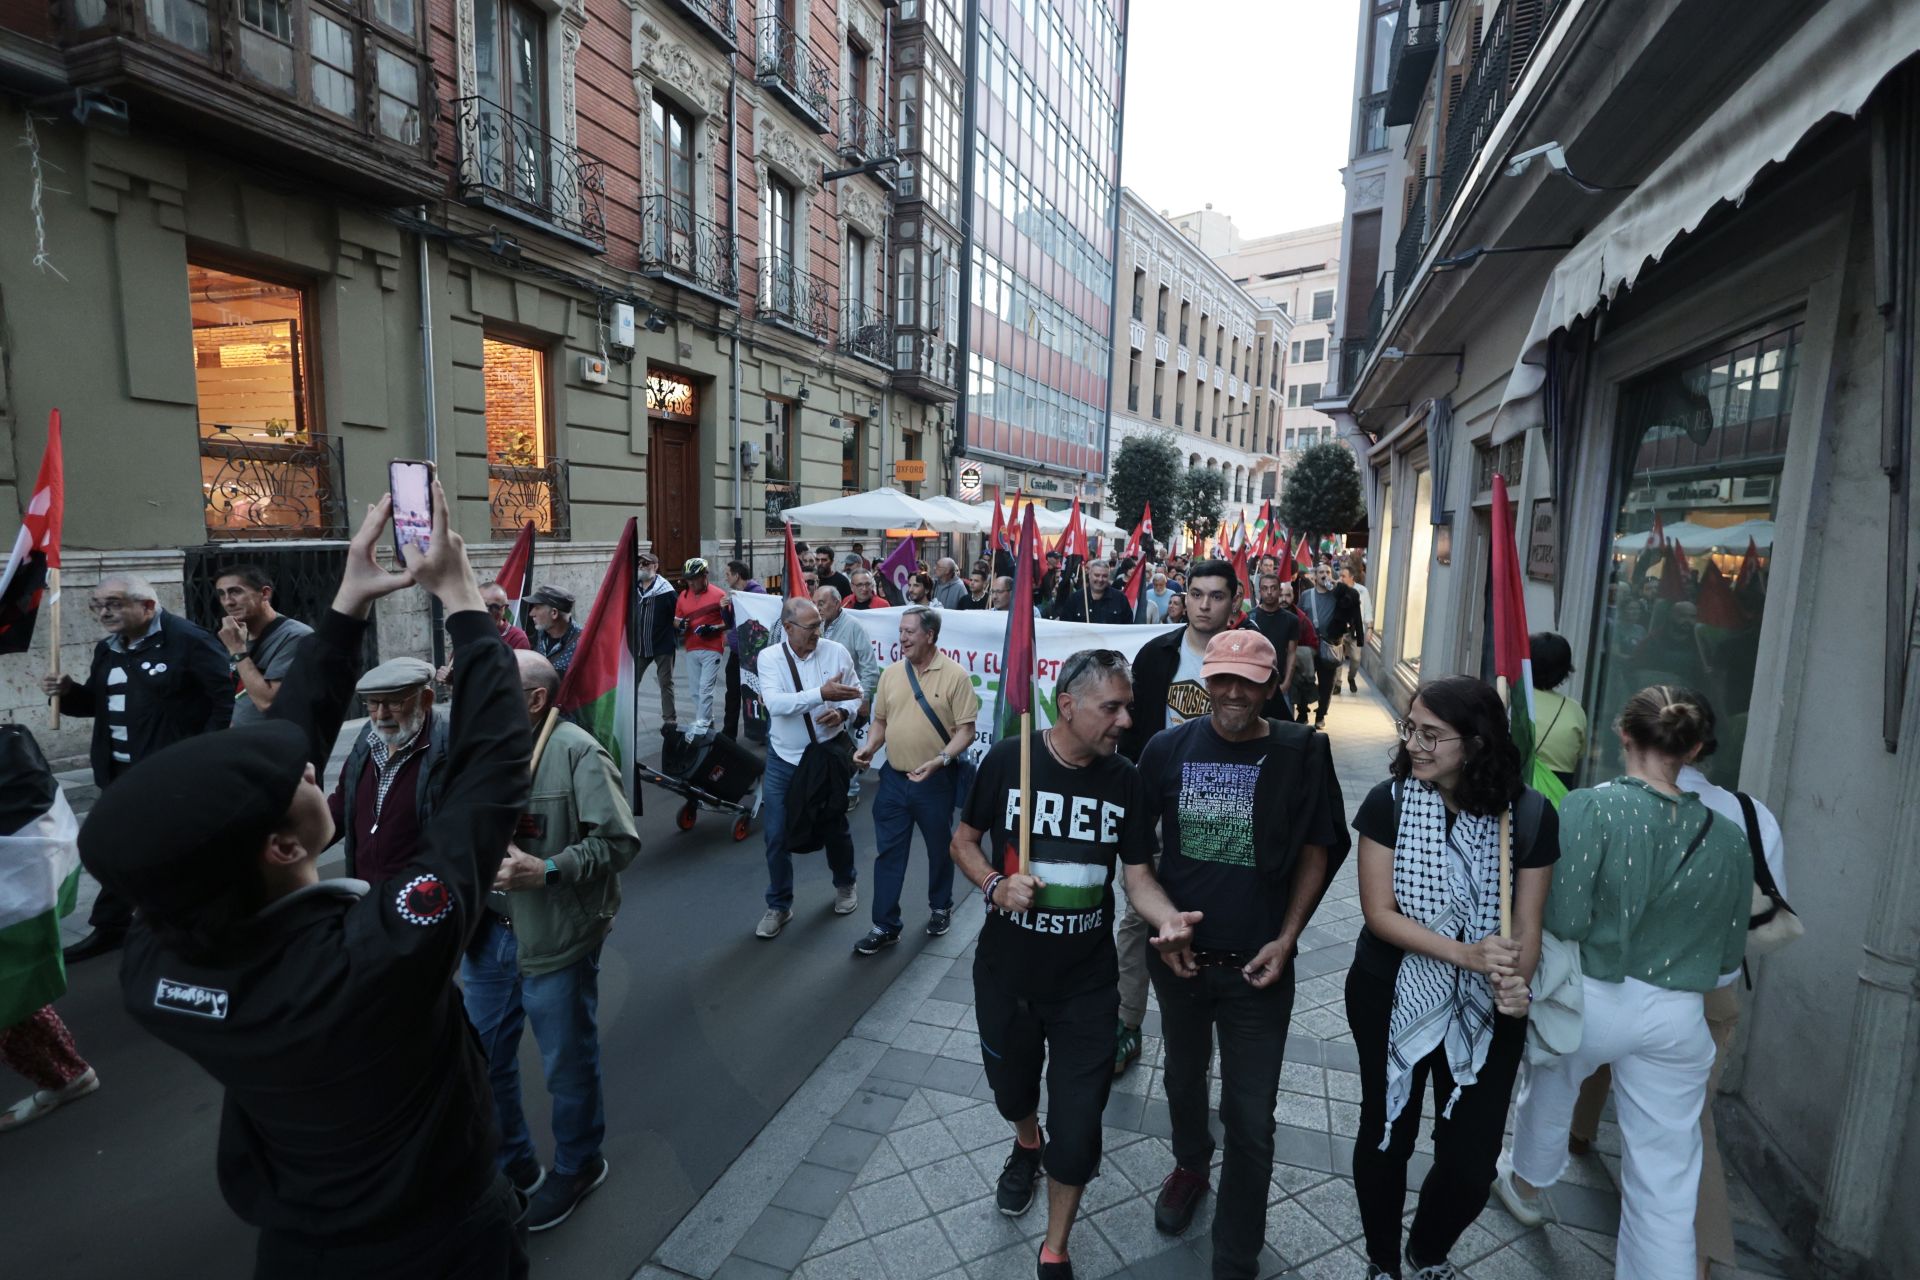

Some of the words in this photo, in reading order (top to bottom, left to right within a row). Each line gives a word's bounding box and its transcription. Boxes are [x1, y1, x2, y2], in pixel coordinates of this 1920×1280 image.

[896, 465, 924, 473] OXFORD
[966, 651, 978, 672] Y
[984, 652, 1001, 674] EL
[1194, 785, 1238, 794] CAGUEN
[1204, 793, 1237, 801] ALCALDE
[1005, 788, 1125, 843] FREE
[1224, 818, 1249, 827] CAGUEN
[1217, 830, 1247, 839] GUERRA
